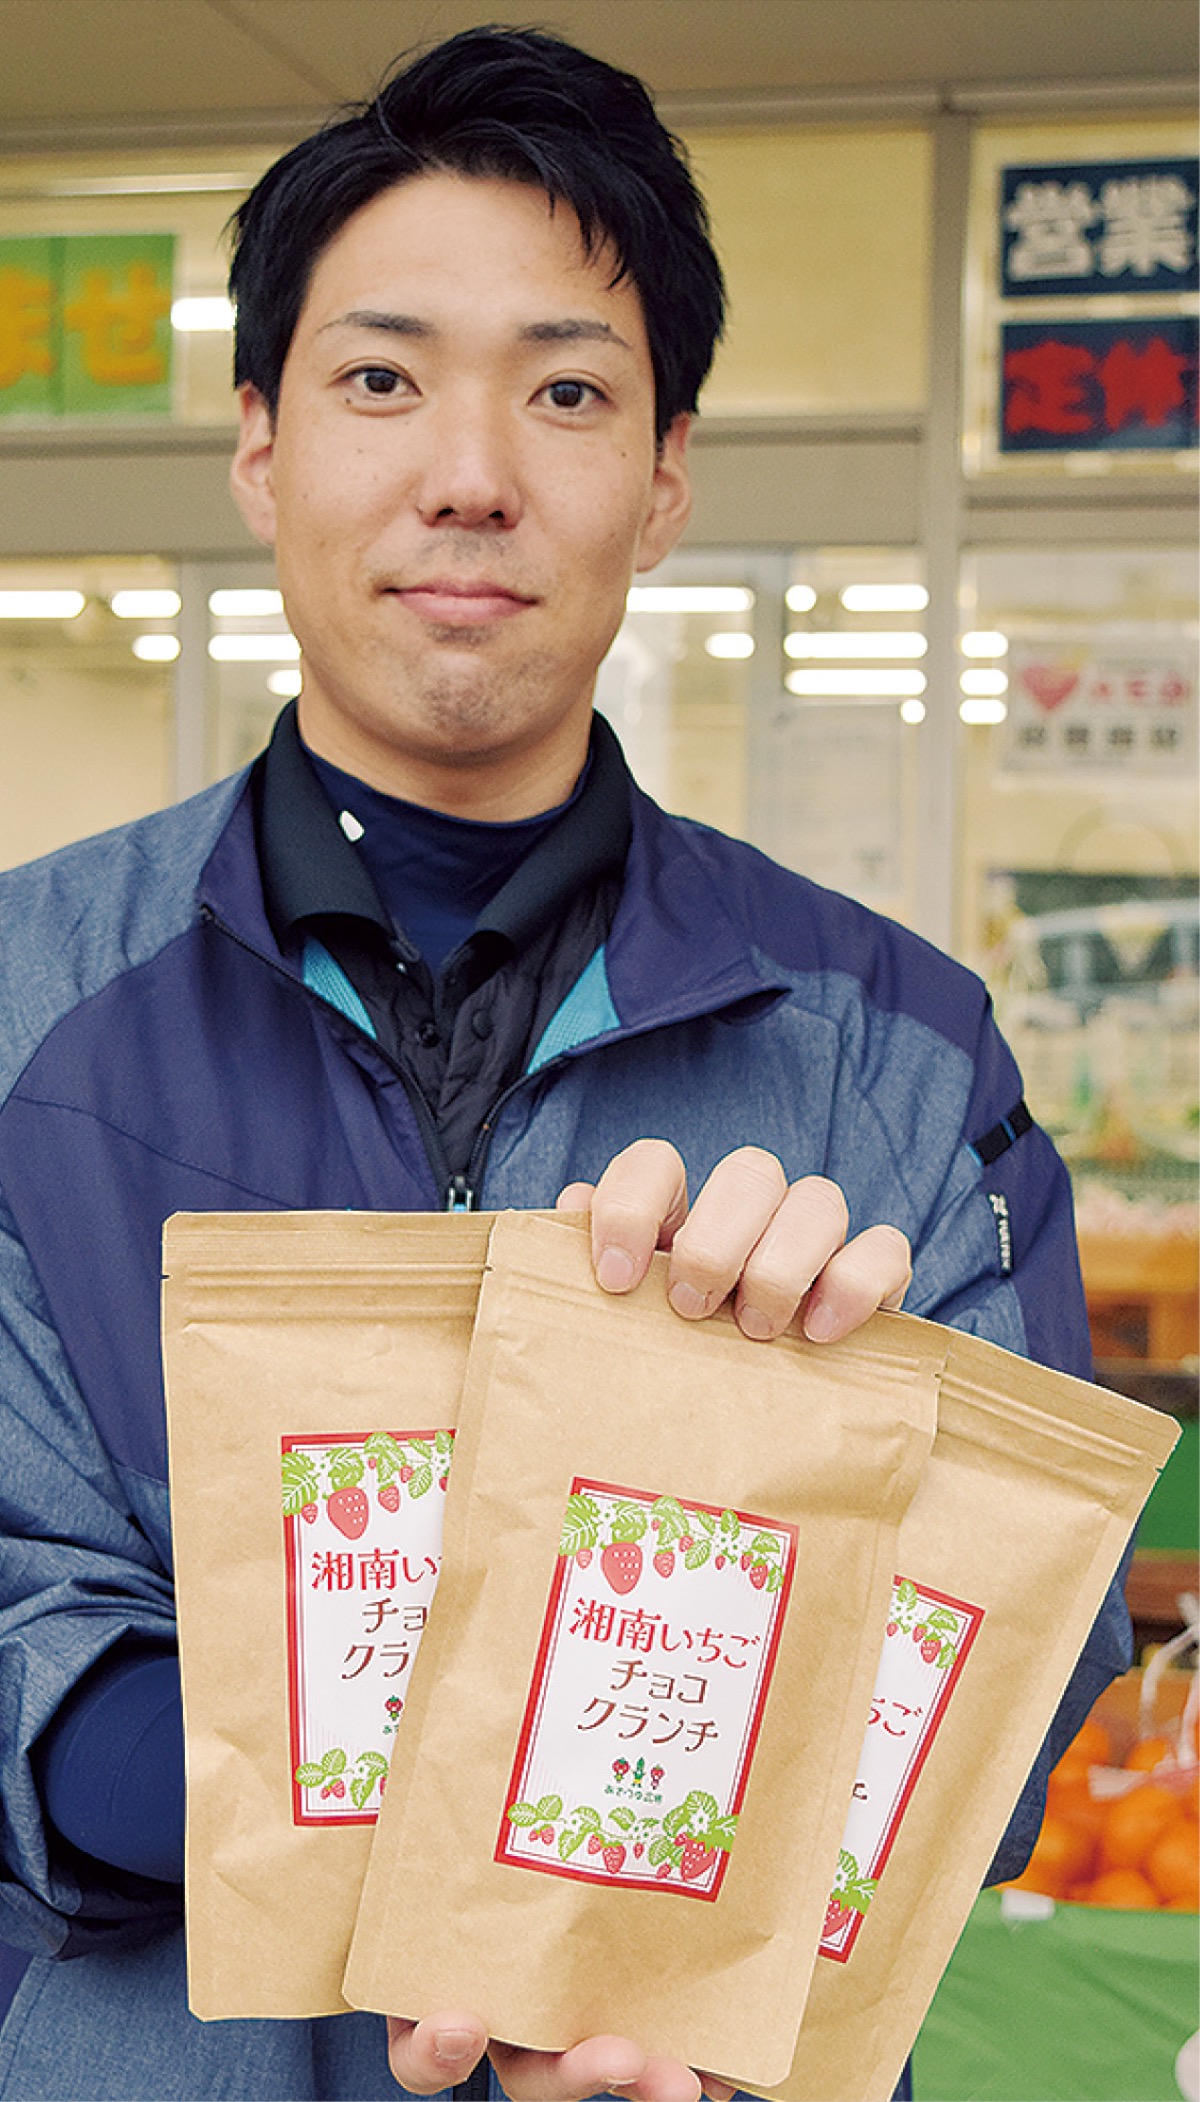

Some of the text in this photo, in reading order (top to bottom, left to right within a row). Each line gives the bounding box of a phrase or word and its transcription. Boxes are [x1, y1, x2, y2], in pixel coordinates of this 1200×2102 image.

[1004, 339, 1200, 434] 定休
[311, 1547, 442, 1591] 湘南い
[362, 1598, 428, 1634] チョ
[568, 1597, 760, 1668] 湘南いちご
[341, 1641, 410, 1680] クラ
[610, 1660, 708, 1704] チョコ
[577, 1697, 719, 1752] クランチ
